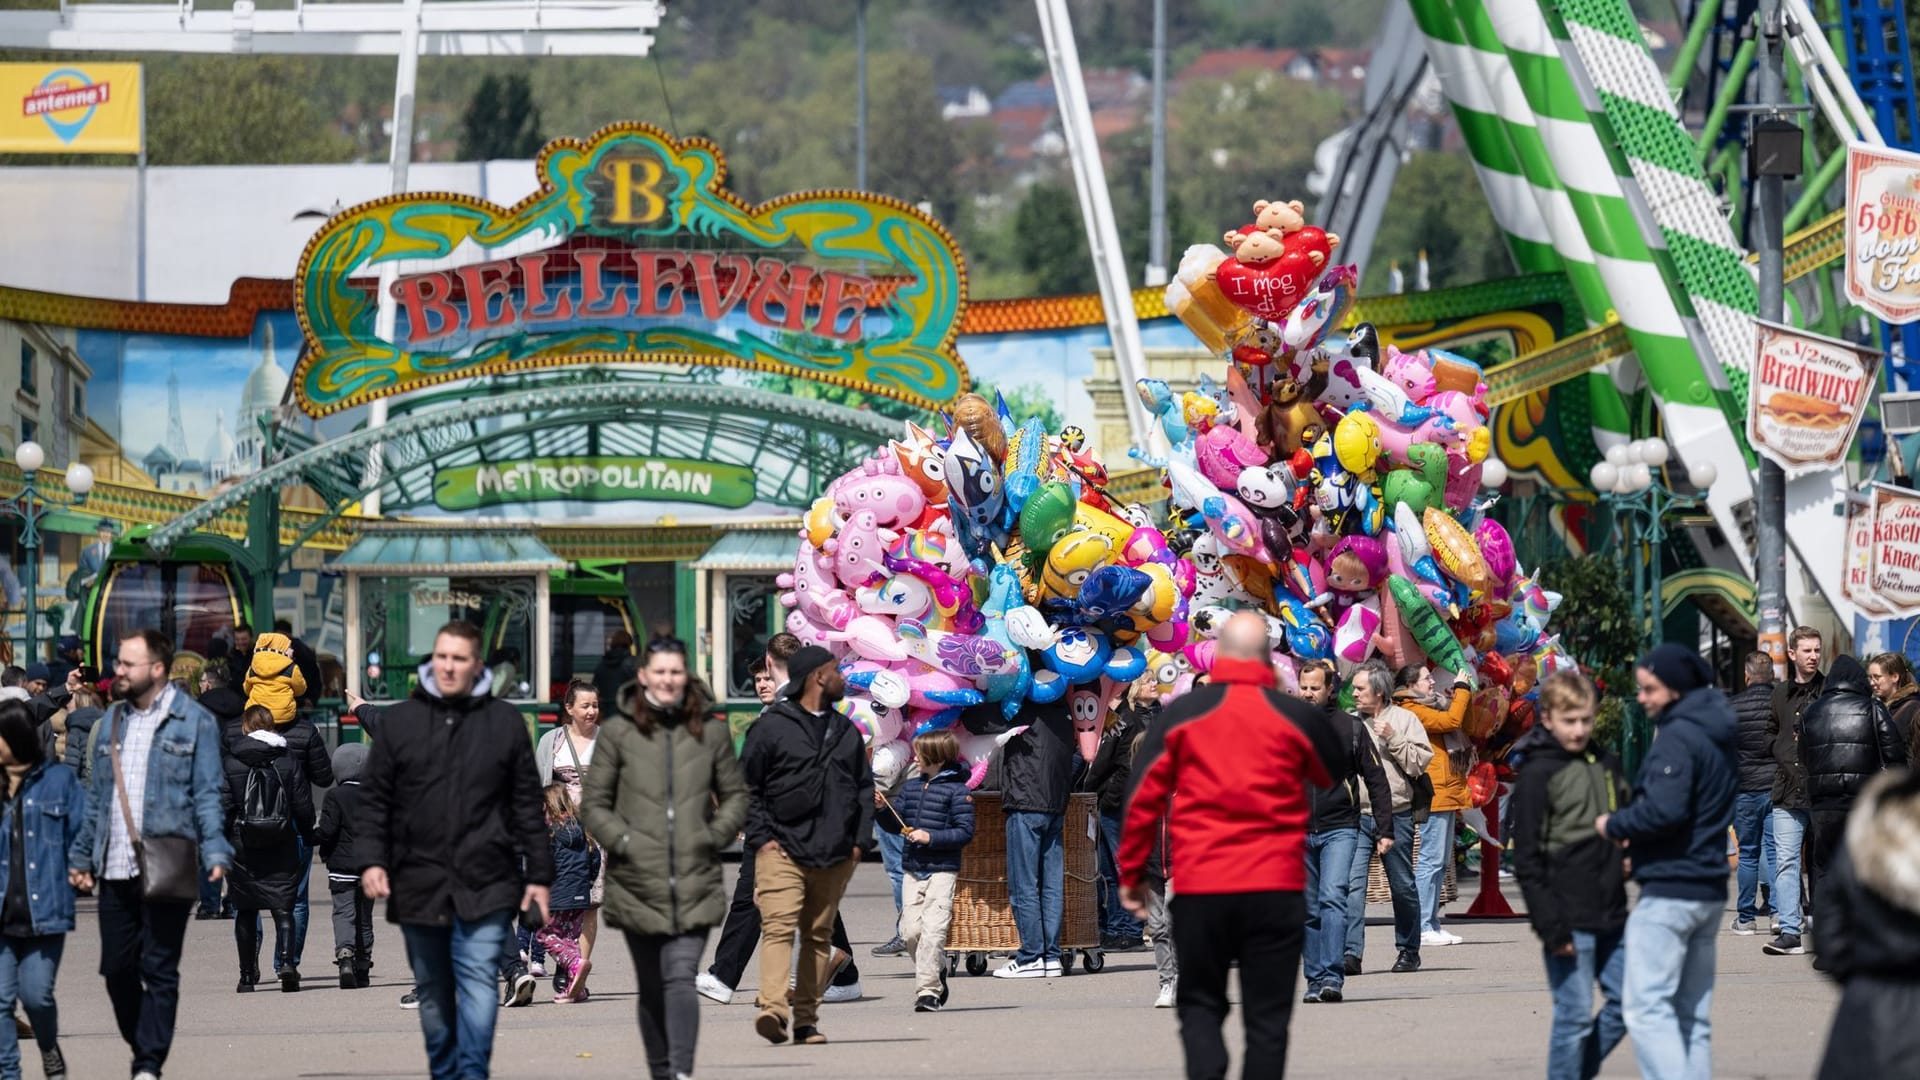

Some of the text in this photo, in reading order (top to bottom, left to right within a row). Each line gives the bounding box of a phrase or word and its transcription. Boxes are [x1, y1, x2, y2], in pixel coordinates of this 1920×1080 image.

[25, 87, 98, 115] antenne
[99, 83, 107, 101] 1
[603, 155, 665, 224] B
[1858, 236, 1920, 263] vom
[389, 248, 877, 344] BELLEVUE
[1232, 273, 1296, 298] I mog
[1257, 294, 1275, 312] di
[1795, 341, 1819, 363] 1/2
[1820, 354, 1853, 374] Meter
[1761, 354, 1862, 407] Bratwurst
[1882, 544, 1920, 573] Knac
